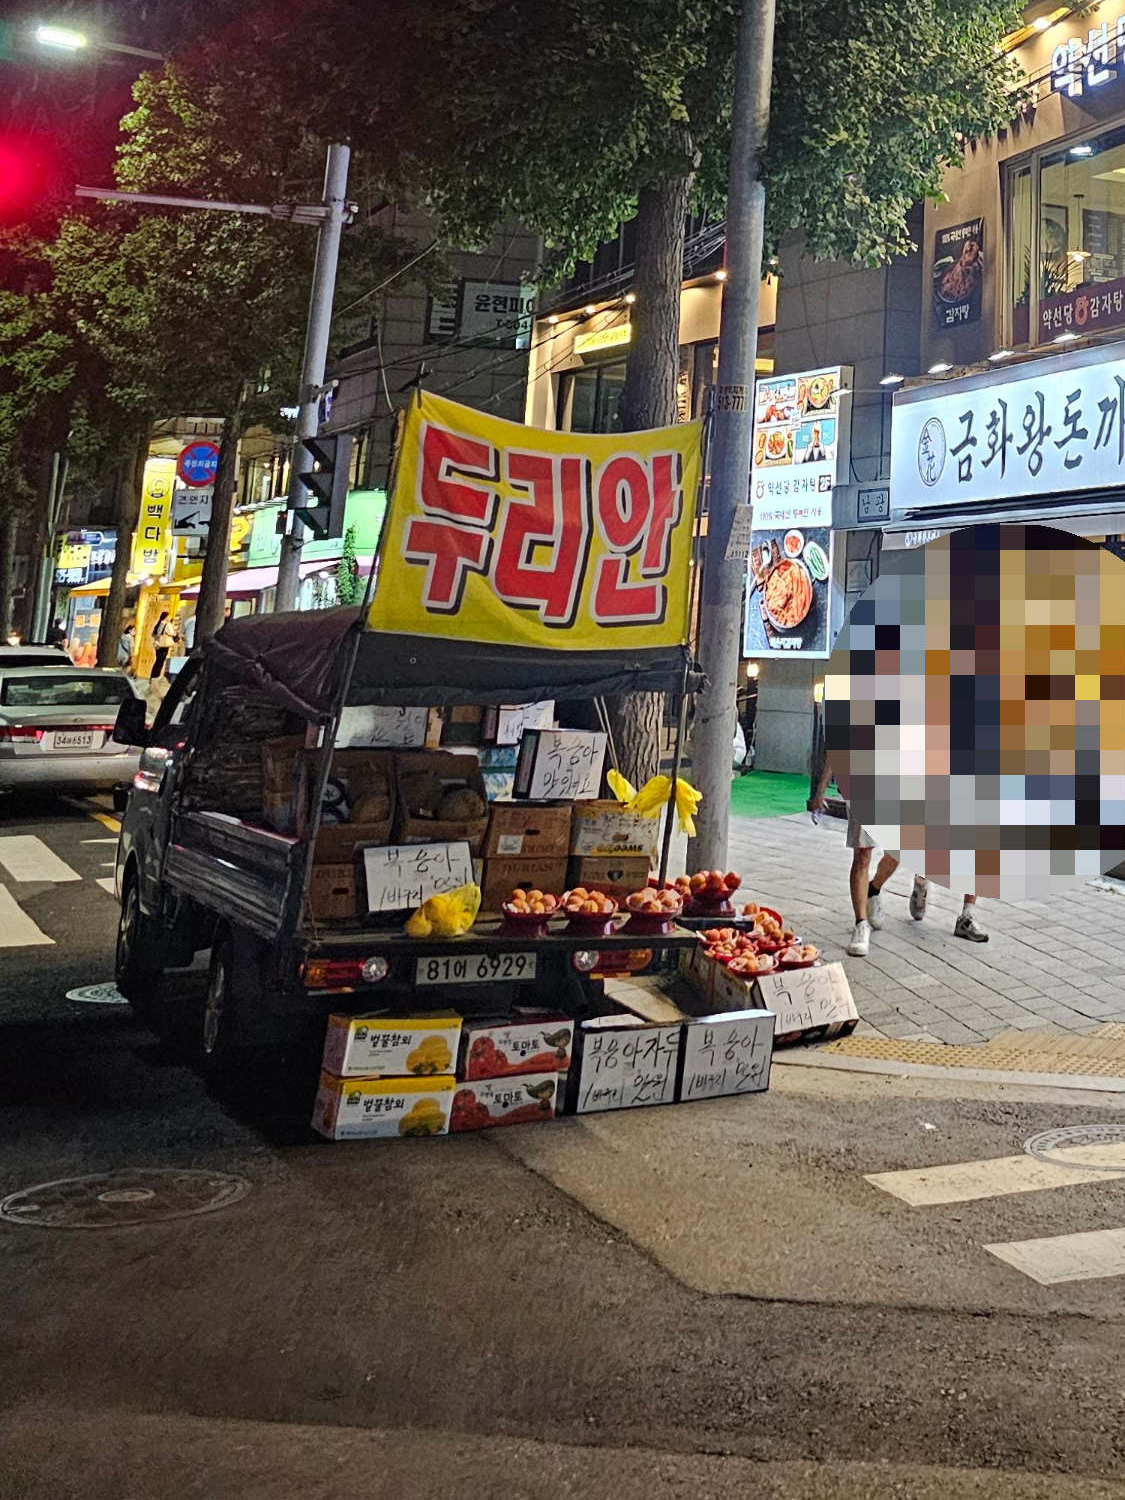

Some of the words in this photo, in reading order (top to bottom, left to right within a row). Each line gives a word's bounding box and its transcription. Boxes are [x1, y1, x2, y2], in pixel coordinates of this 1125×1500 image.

[1042, 304, 1074, 330] 약선당
[1090, 290, 1124, 319] 감자탕
[766, 478, 791, 497] 약선당
[177, 493, 214, 506] 견인지
[143, 503, 165, 565] 빽다방
[402, 420, 685, 630] 두리안
[547, 734, 600, 770] 복숭아
[426, 958, 468, 983] 81어
[476, 954, 528, 979] 6929
[369, 1033, 413, 1048] 벌꿀참외
[510, 1038, 541, 1054] 토마토
[362, 1097, 405, 1113] 벌꿀참외
[492, 1090, 524, 1106] 토마토
